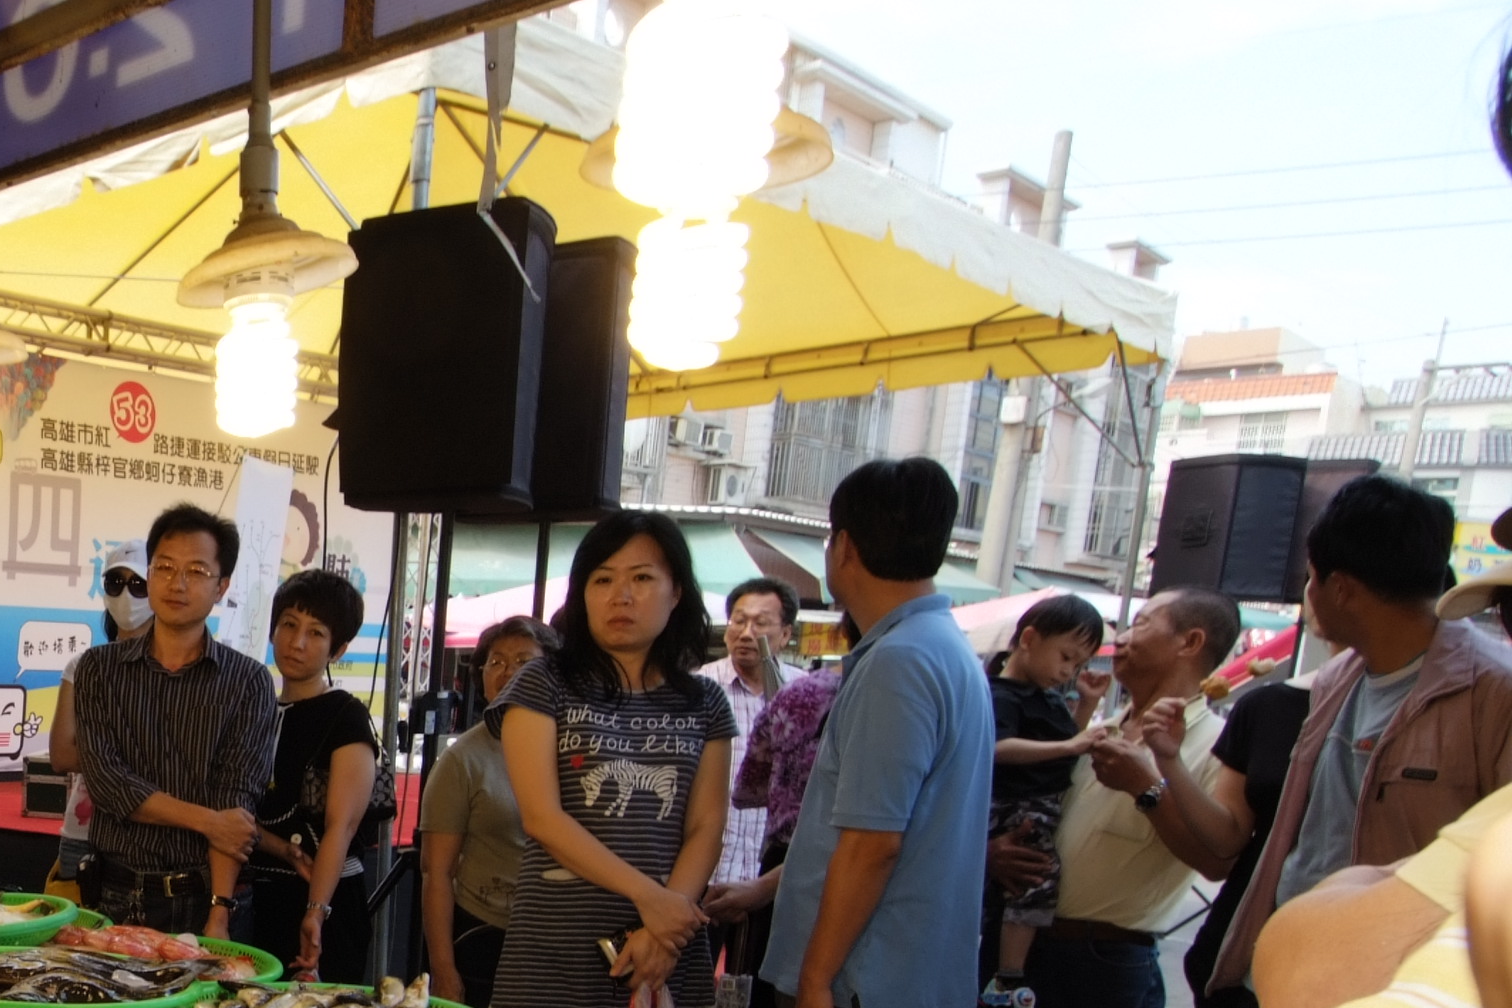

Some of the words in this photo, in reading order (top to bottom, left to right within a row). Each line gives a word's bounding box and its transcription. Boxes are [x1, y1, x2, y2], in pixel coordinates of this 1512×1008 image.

[40, 418, 112, 448] 高雄市紅
[112, 391, 152, 434] 53
[630, 713, 701, 731] color
[558, 729, 581, 753] do
[588, 733, 634, 755] you
